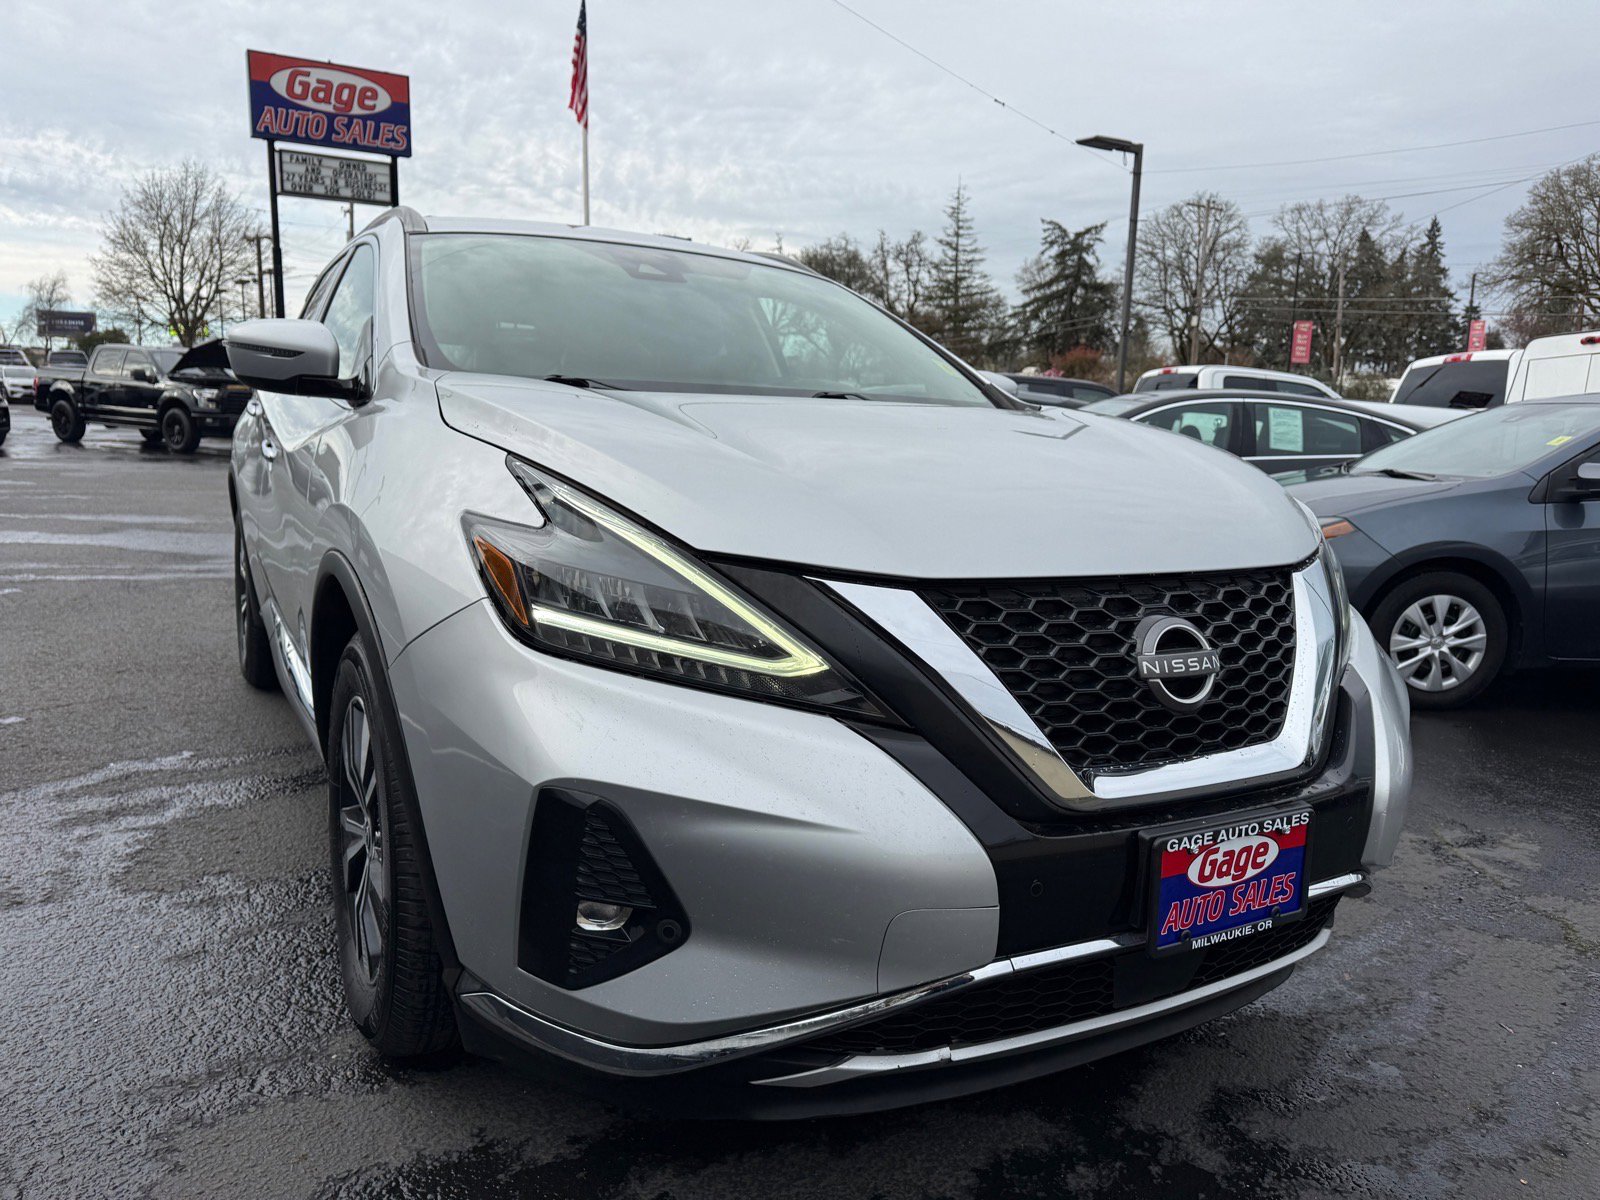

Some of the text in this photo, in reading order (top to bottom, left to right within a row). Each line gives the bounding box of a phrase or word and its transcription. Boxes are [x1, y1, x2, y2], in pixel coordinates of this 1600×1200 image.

[285, 69, 379, 113] Gage
[256, 105, 408, 150] AUTO SALES
[289, 154, 323, 166] FAMILY
[305, 165, 321, 175] AND
[290, 182, 313, 192] OVER
[298, 174, 325, 185] YEARS
[330, 177, 338, 185] IN
[1142, 655, 1220, 674] NISSAN
[1167, 812, 1310, 853] GAGE AUTO SALES
[1197, 842, 1270, 884] Gage
[1161, 872, 1296, 935] AUTO SALES
[1192, 920, 1273, 950] MILWAUKIE, OR
